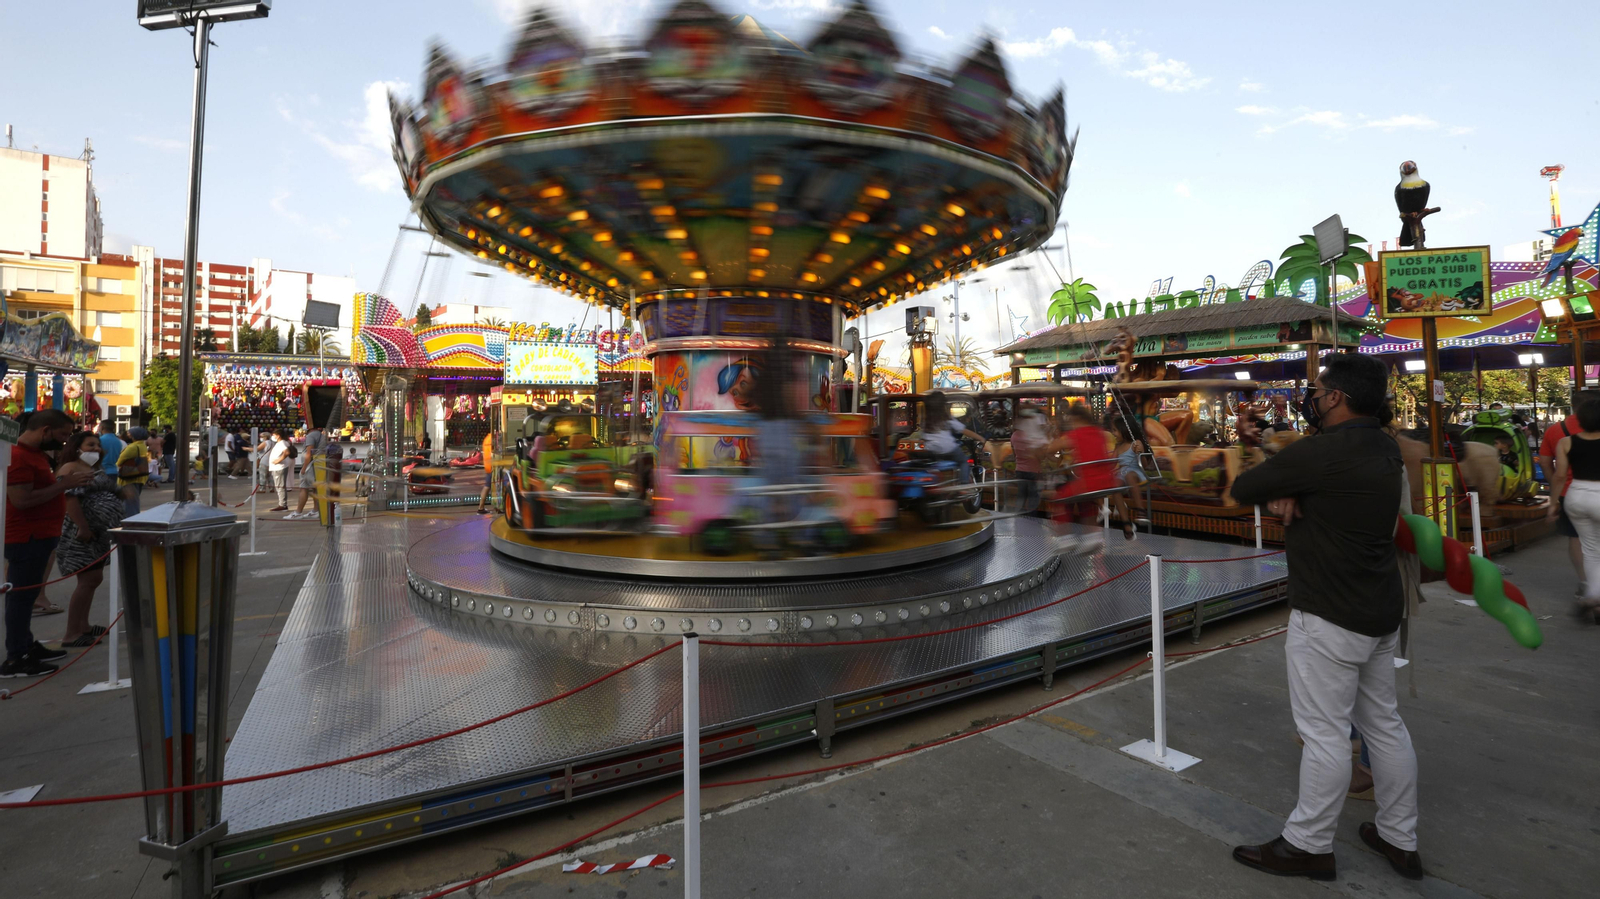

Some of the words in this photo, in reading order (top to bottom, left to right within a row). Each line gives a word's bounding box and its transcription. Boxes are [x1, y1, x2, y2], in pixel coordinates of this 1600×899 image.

[1398, 256, 1422, 266] LOS
[1428, 254, 1468, 264] PAPAS
[1390, 266, 1436, 277] PUEDEN
[1441, 264, 1477, 274] SUBIR
[1407, 277, 1462, 290] GRATIS
[513, 350, 535, 377] BABY
[538, 346, 549, 359] DE
[552, 346, 590, 376] CADENAS
